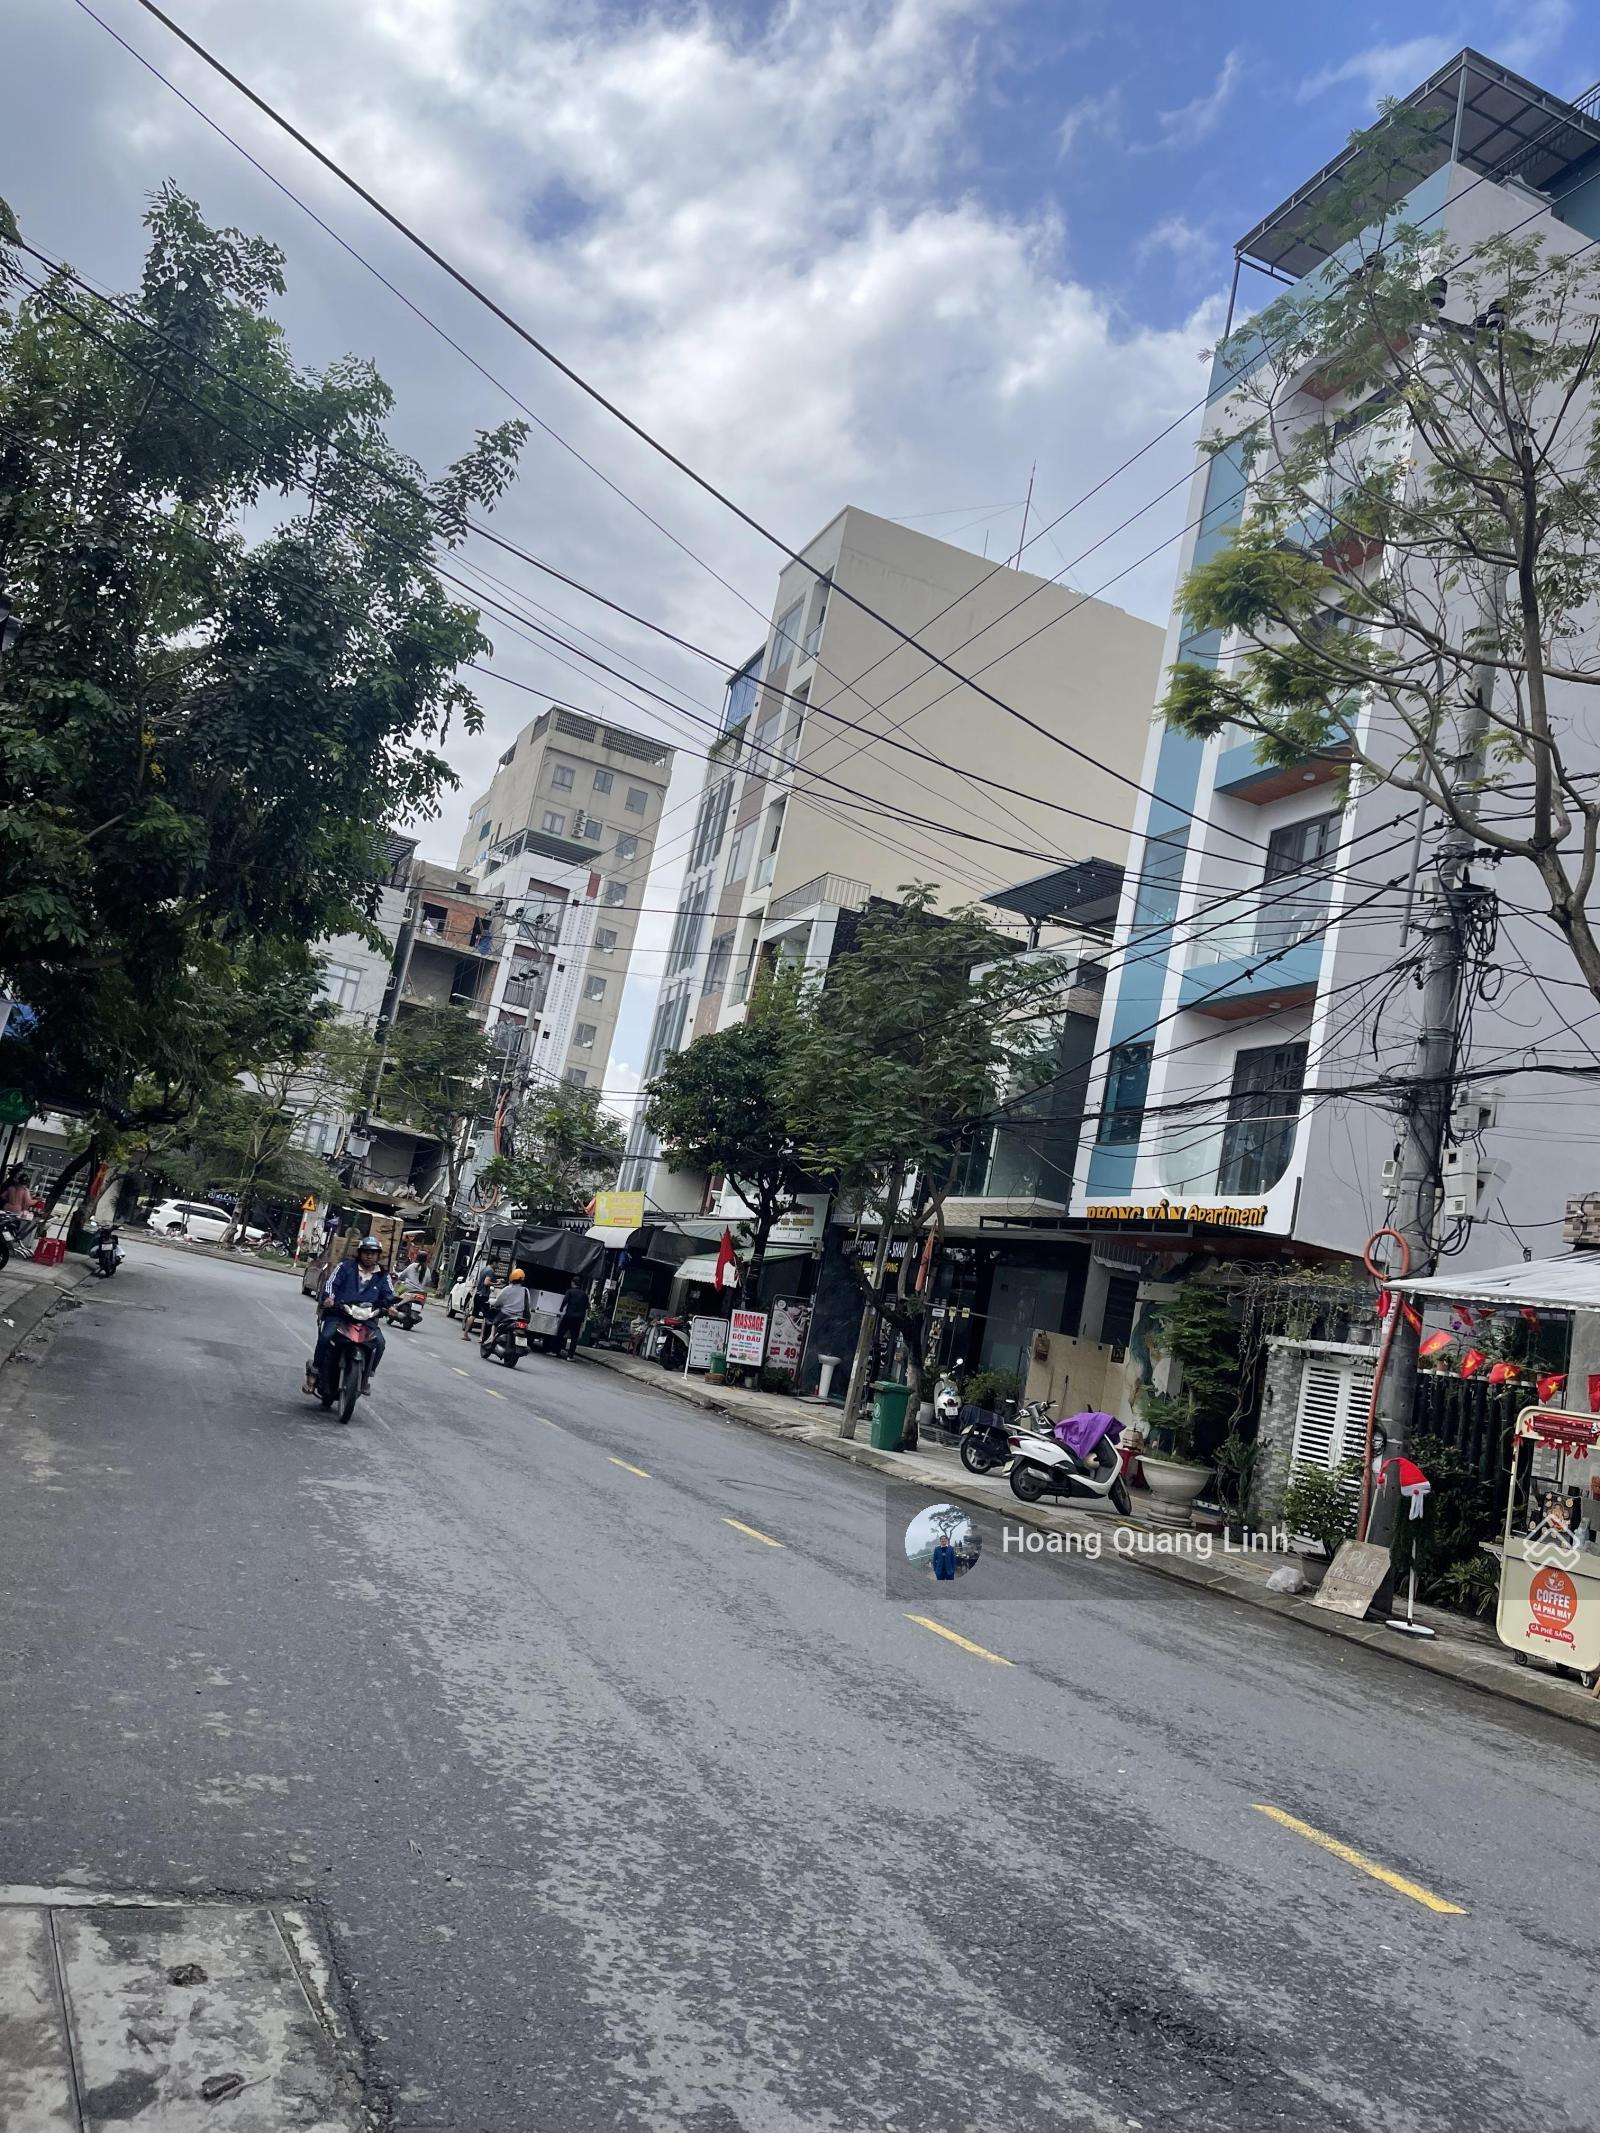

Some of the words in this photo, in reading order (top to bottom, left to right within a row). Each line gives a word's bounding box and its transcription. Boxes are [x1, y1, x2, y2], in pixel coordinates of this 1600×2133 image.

[1187, 1204, 1267, 1225] Apartment
[734, 1313, 765, 1331] MASSAGE
[1536, 1588, 1570, 1608] COFFEE
